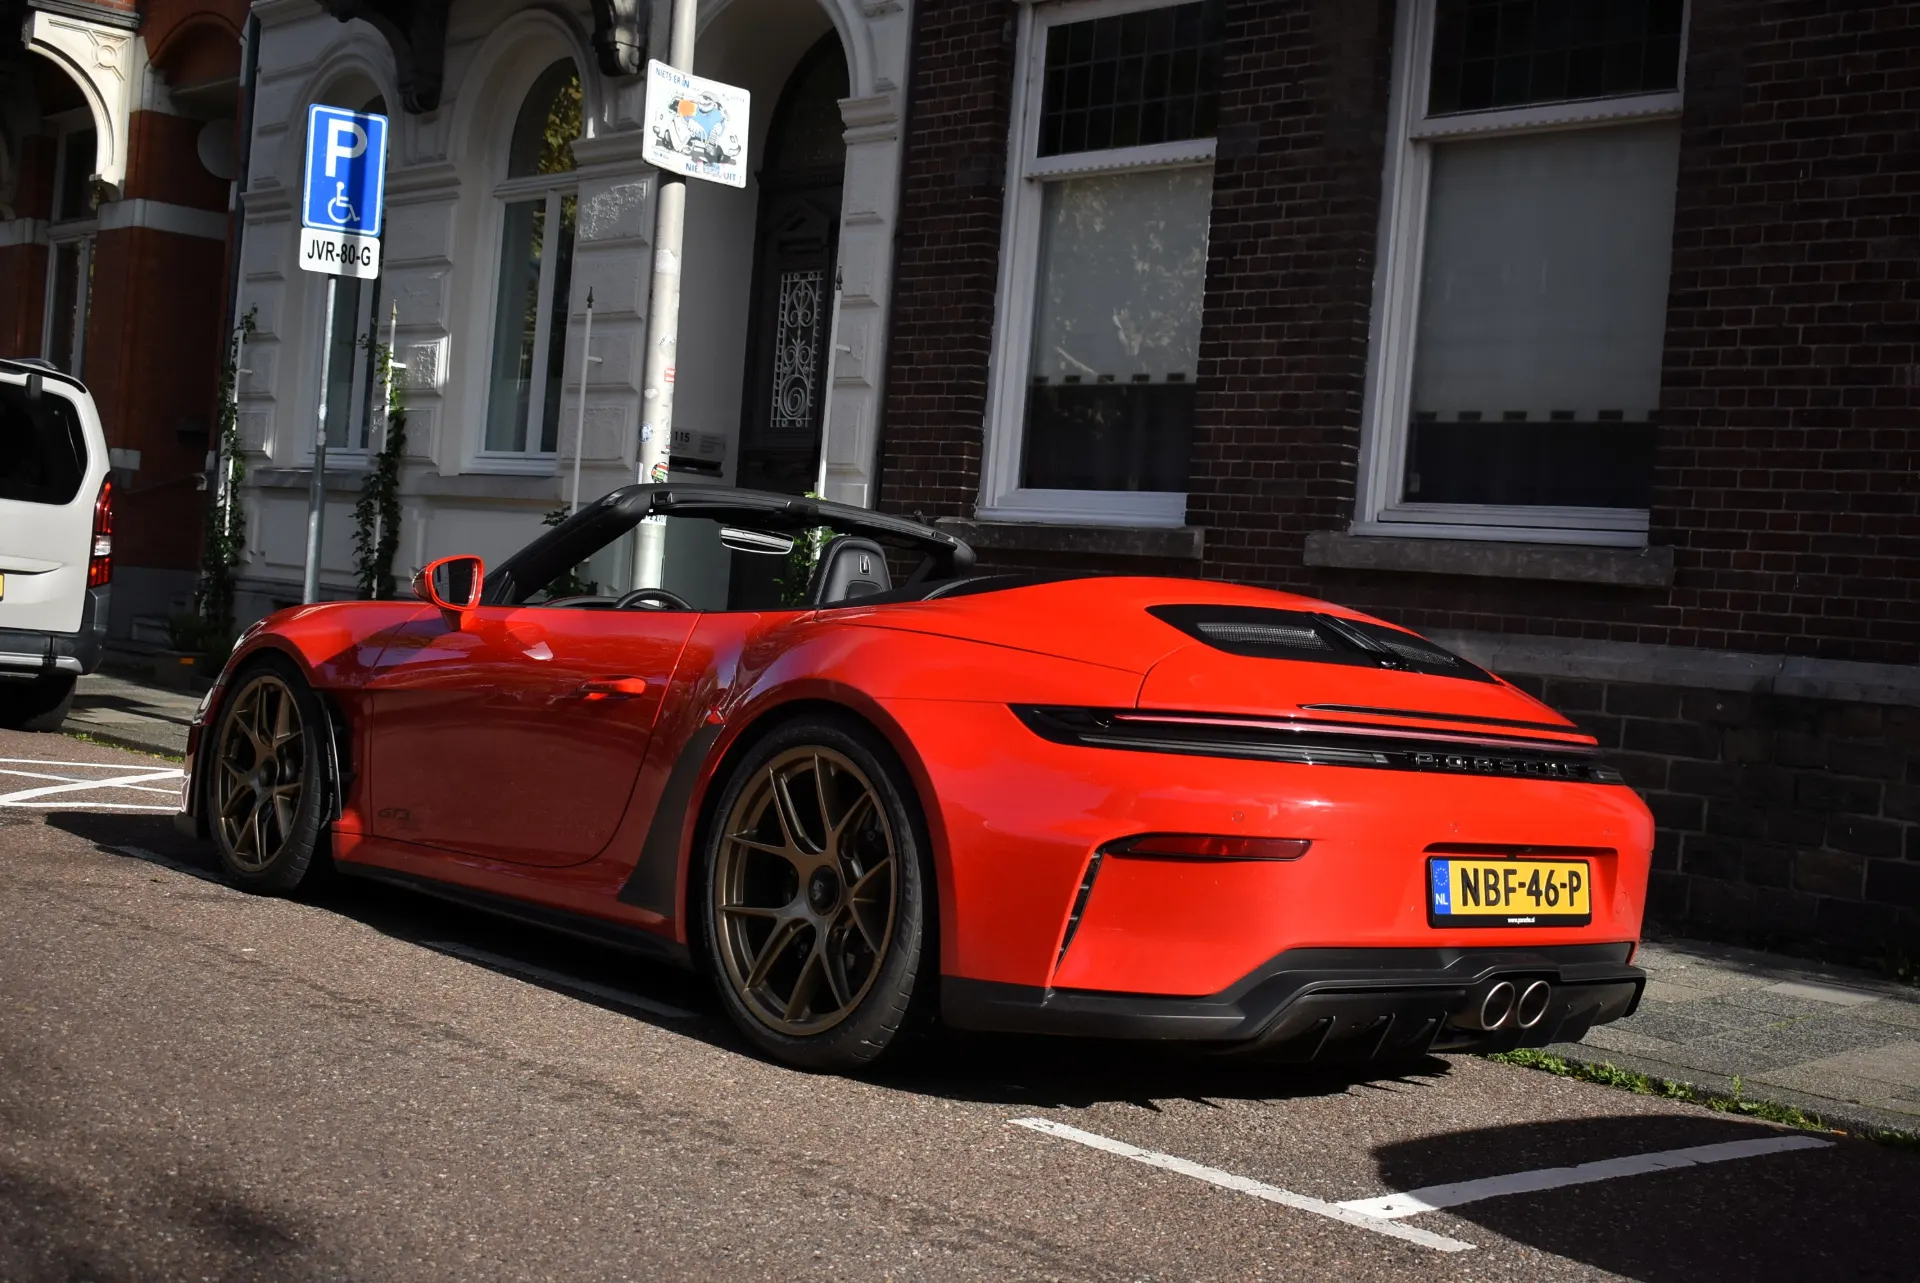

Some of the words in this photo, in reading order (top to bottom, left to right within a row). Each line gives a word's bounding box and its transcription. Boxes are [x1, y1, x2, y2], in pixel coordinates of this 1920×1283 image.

[325, 117, 368, 178] P
[307, 238, 371, 267] JVR-80-G
[674, 430, 691, 443] 115
[1415, 752, 1579, 777] PORSCHE
[1434, 892, 1450, 906] NL
[1460, 867, 1582, 908] NBF-46-P
